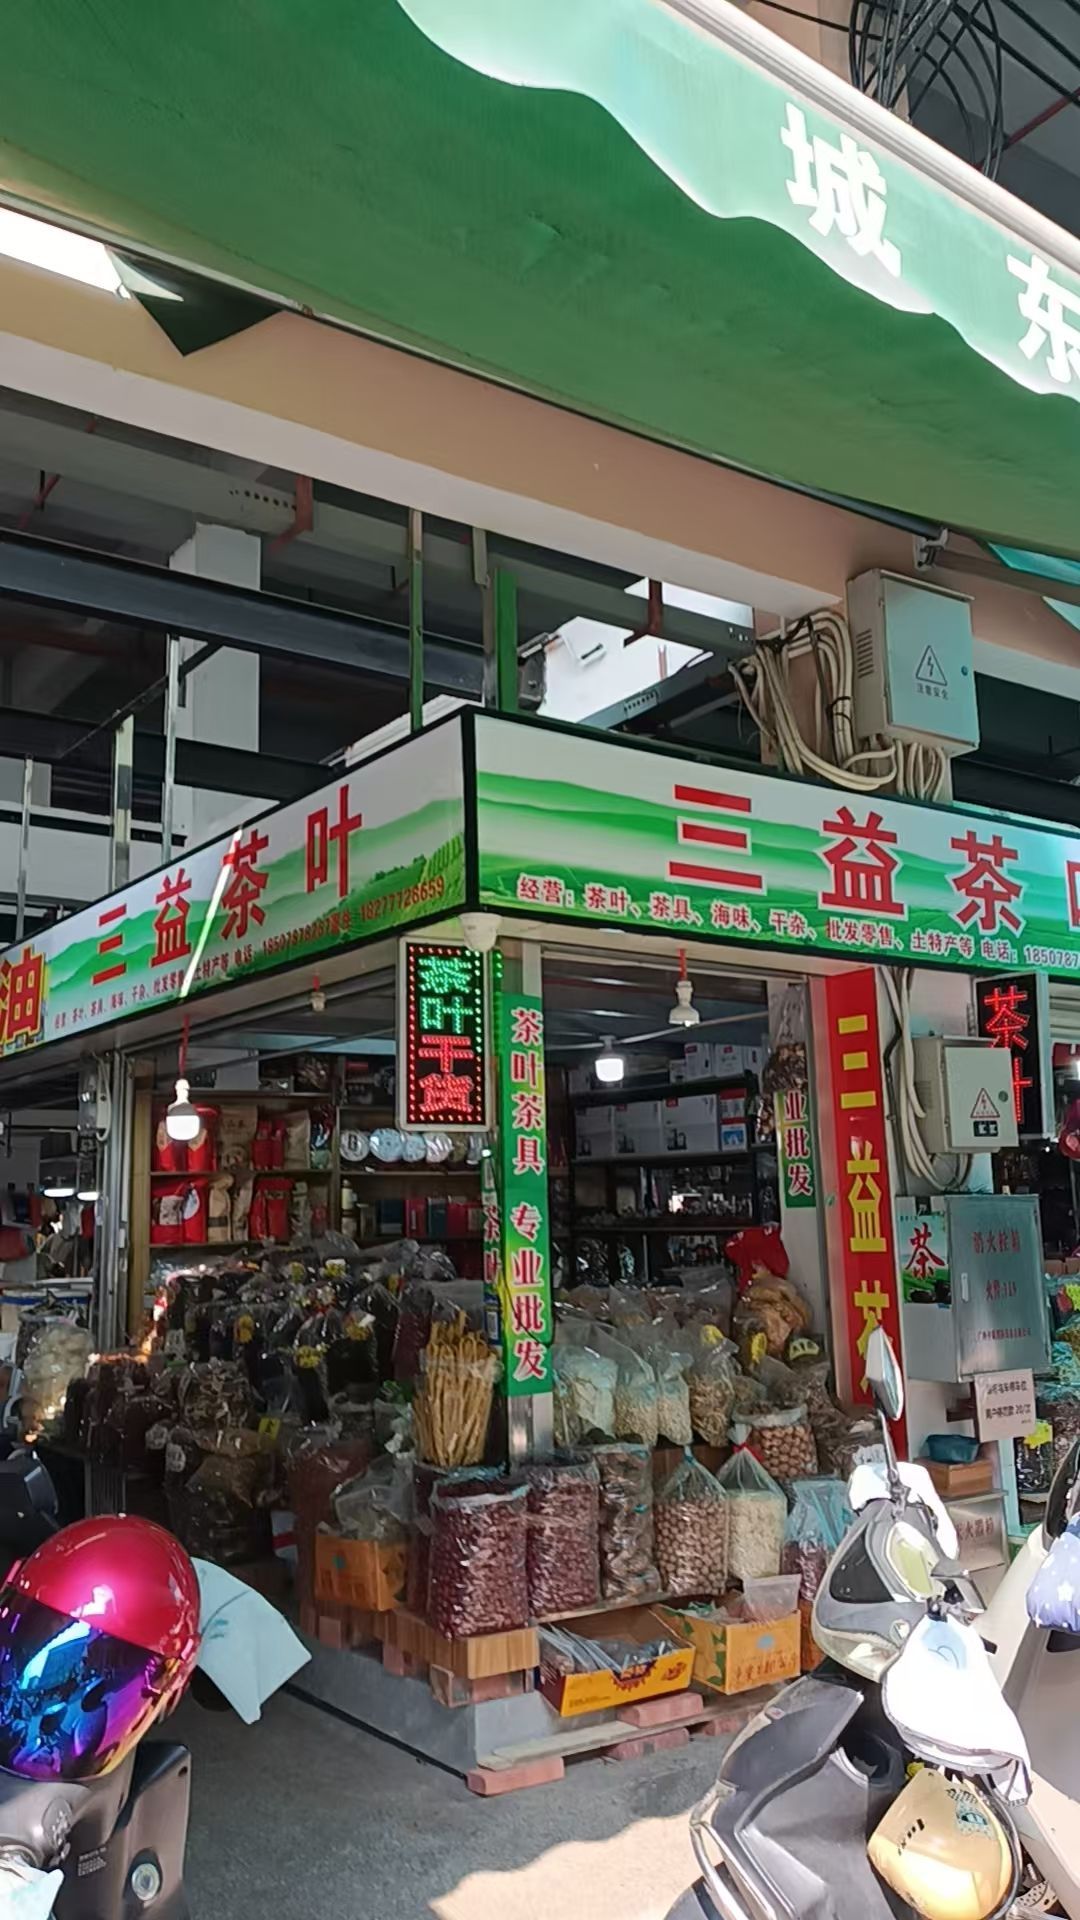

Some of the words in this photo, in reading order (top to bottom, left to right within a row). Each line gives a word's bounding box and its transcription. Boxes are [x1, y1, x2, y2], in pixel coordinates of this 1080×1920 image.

[92, 784, 362, 985] 三益茶叶
[669, 784, 1080, 936] 三益茶
[511, 1007, 544, 1176] 茶叶茶具
[511, 1203, 546, 1382] 专业批发
[905, 1222, 946, 1279] 茶
